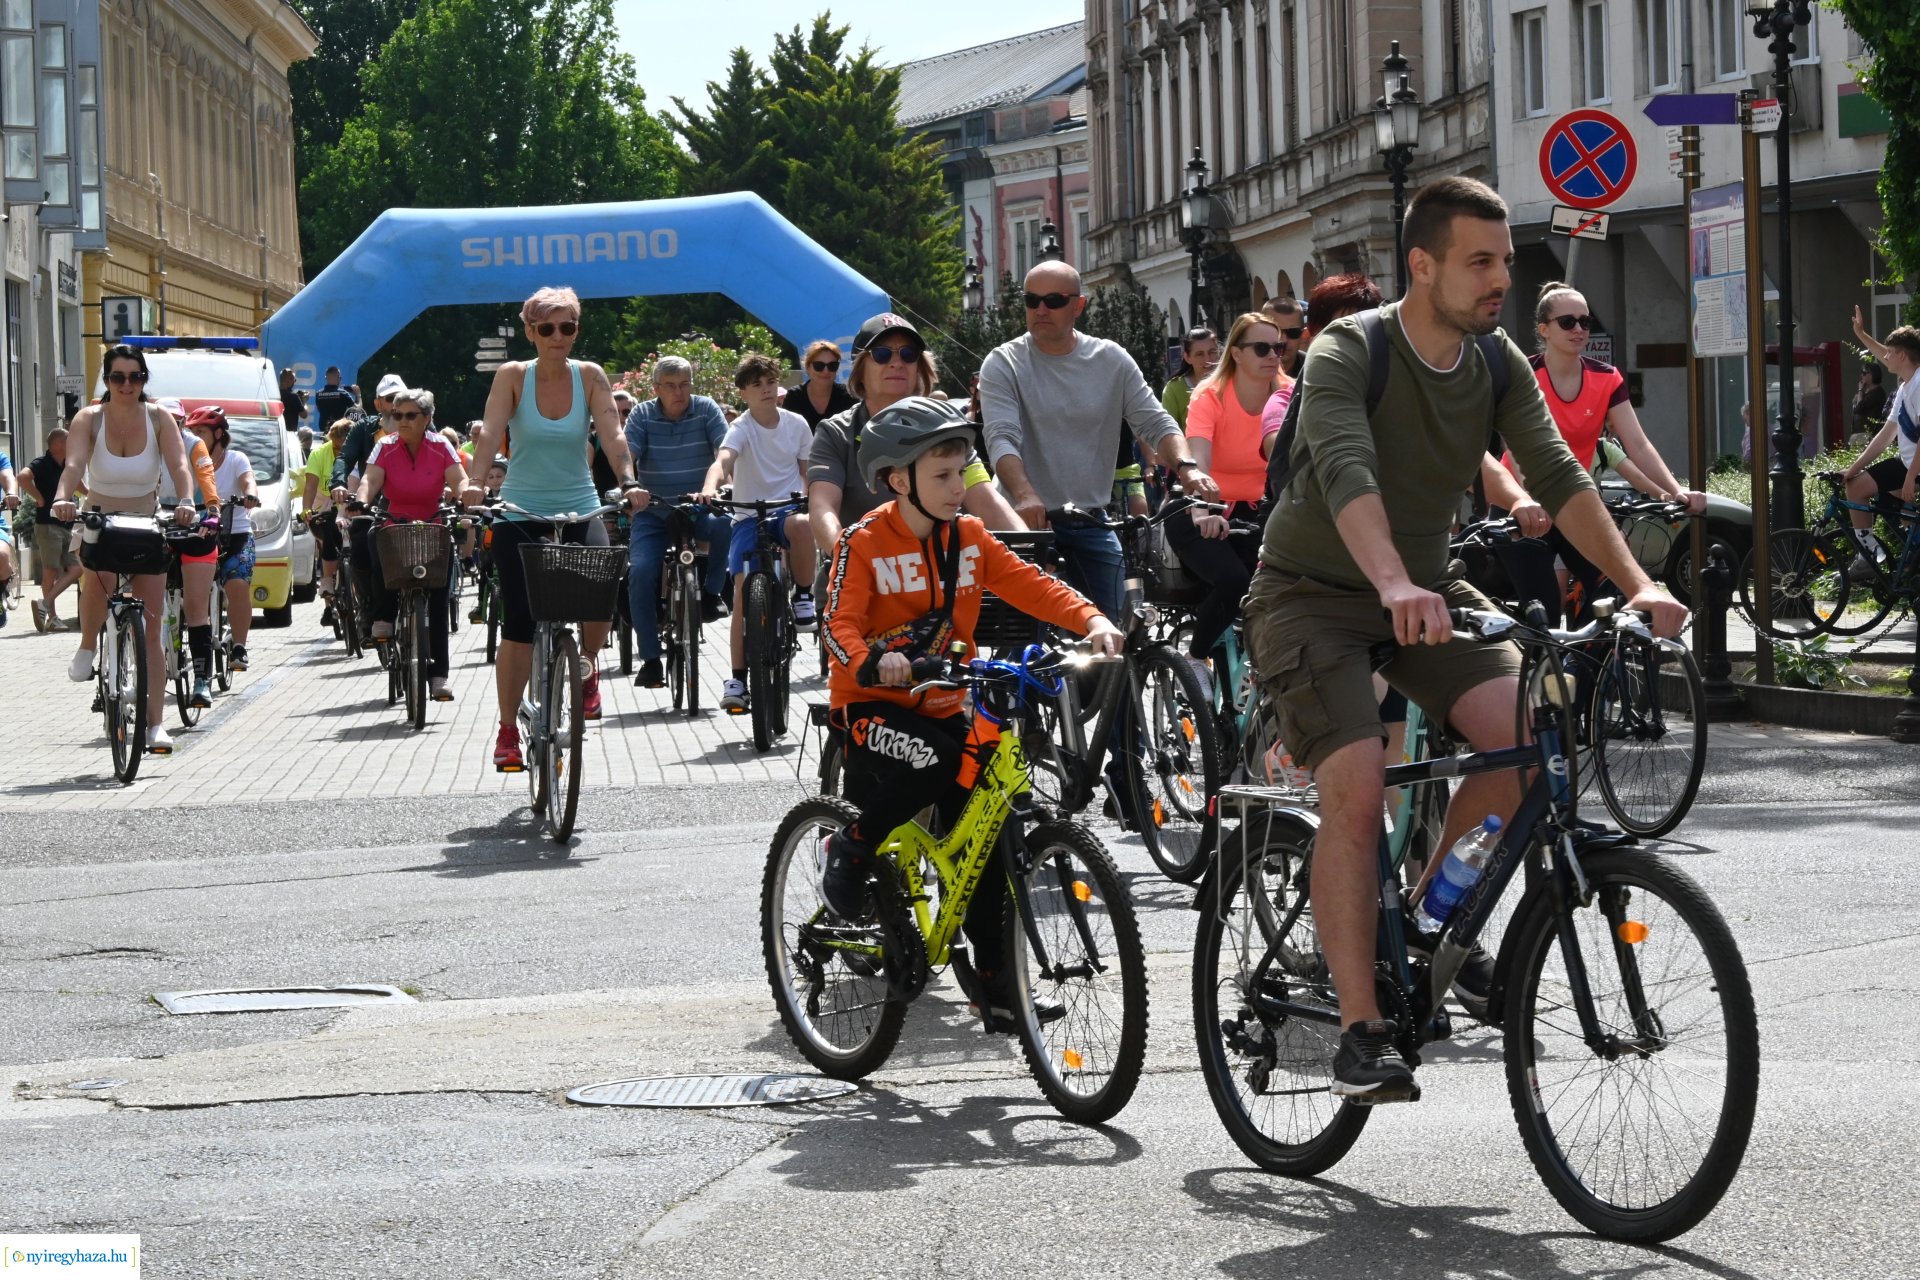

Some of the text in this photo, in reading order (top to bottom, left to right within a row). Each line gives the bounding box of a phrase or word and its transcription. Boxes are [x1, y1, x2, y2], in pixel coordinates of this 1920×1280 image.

[461, 228, 678, 268] SHIMANO
[872, 544, 981, 595] NEF
[955, 820, 1001, 917] EXPLORER
